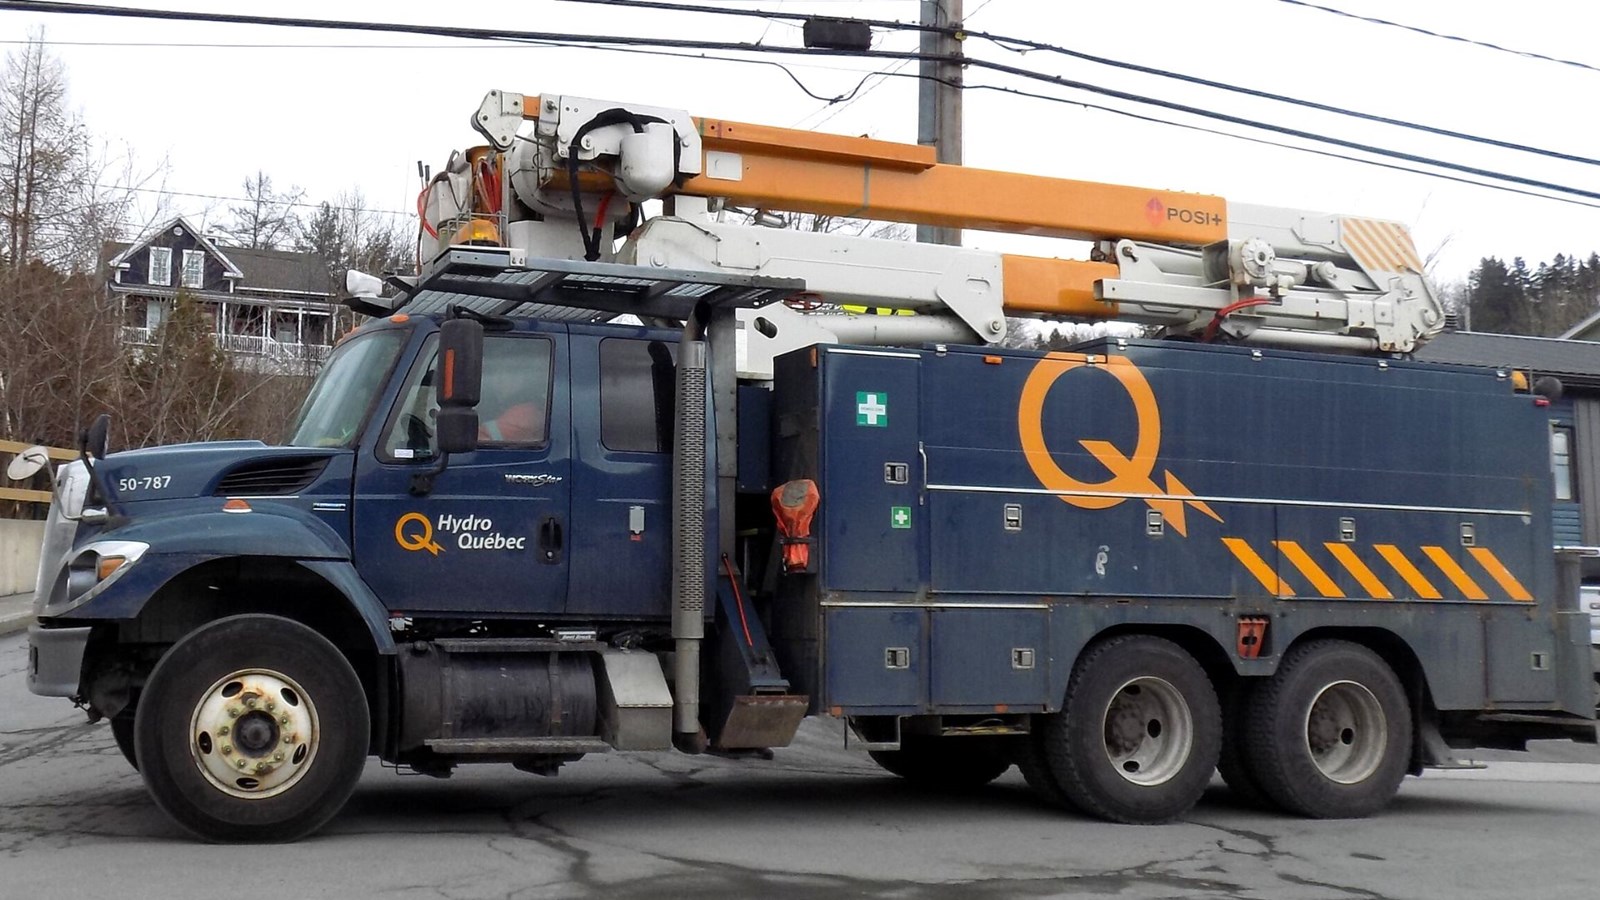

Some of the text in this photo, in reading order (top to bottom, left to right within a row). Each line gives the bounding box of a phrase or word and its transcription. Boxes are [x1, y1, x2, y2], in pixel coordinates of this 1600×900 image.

[1167, 207, 1222, 226] POSI+
[119, 475, 171, 491] 50-787
[437, 514, 492, 534] Hydro
[458, 532, 526, 549] Québec
